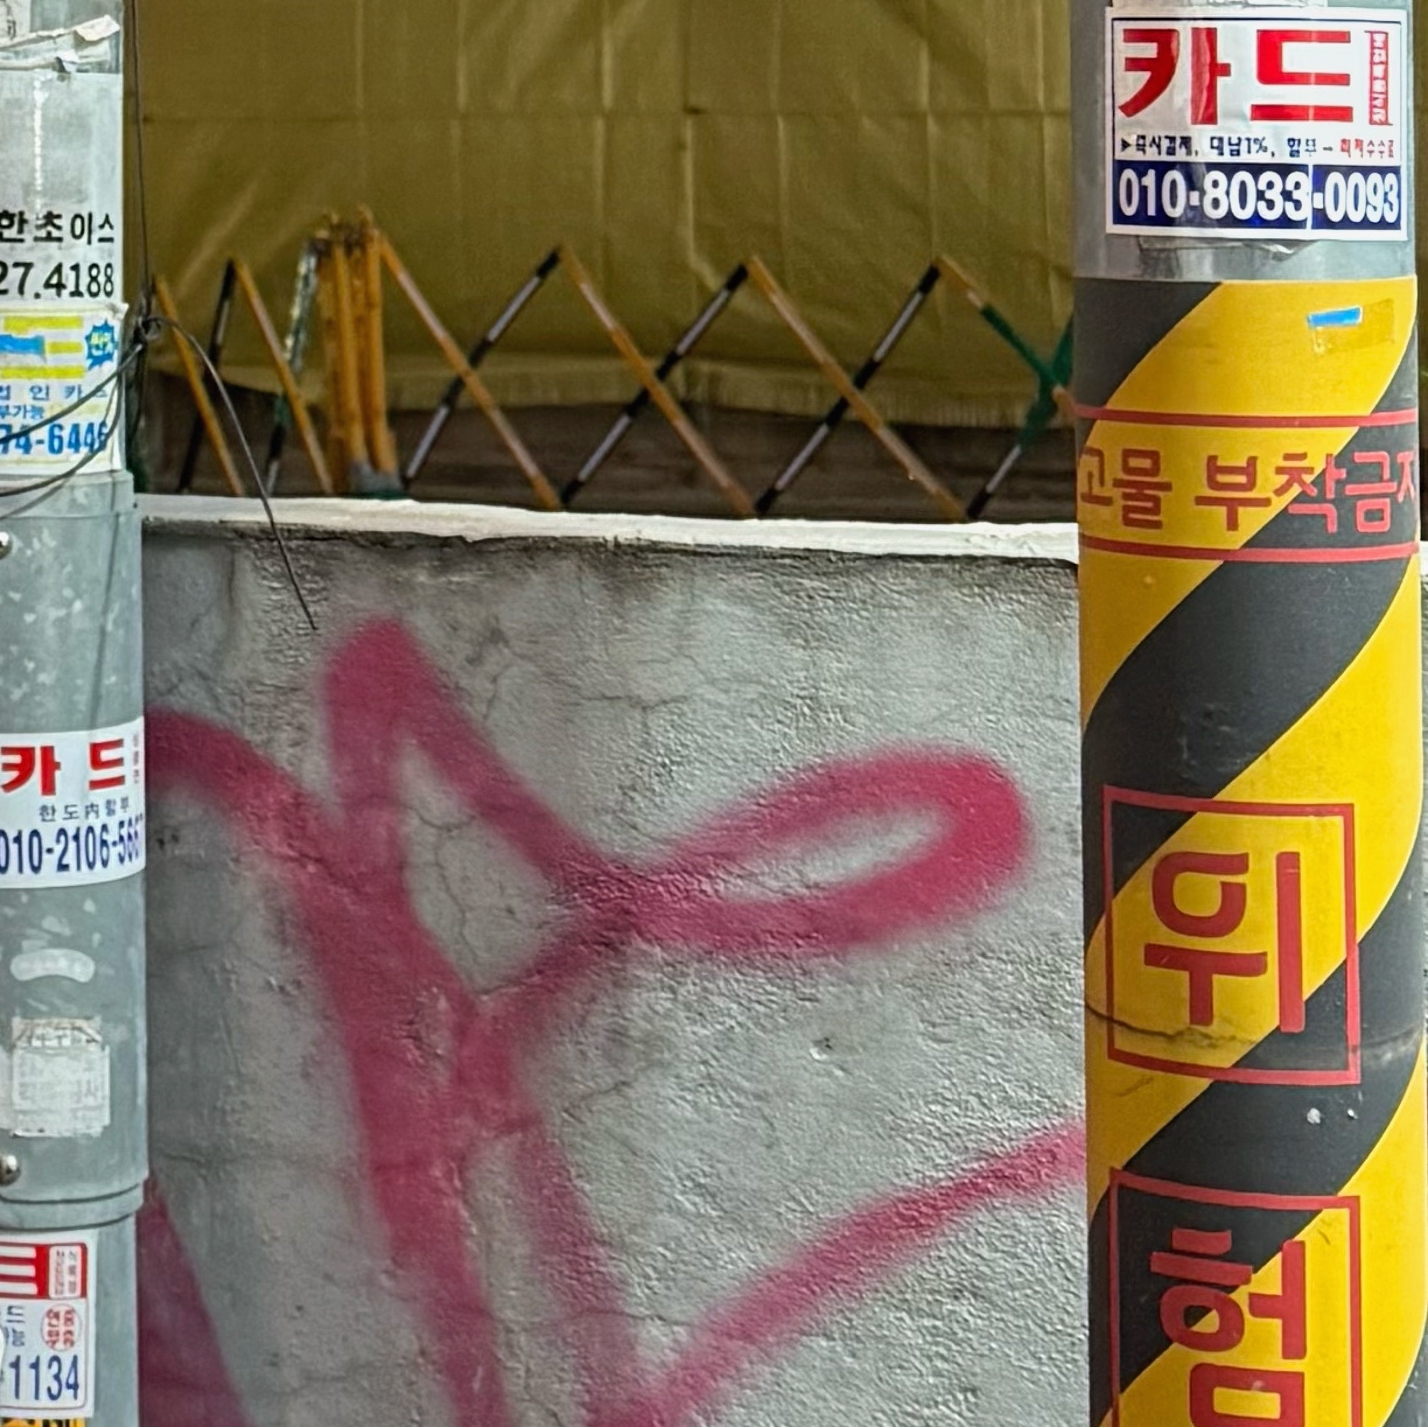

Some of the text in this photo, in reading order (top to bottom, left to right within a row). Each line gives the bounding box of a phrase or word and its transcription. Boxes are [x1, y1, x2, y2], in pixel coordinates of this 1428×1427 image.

[1118, 27, 1354, 126] 카드
[1118, 168, 1399, 224] 010-8033-0093
[0, 738, 127, 797] 카드
